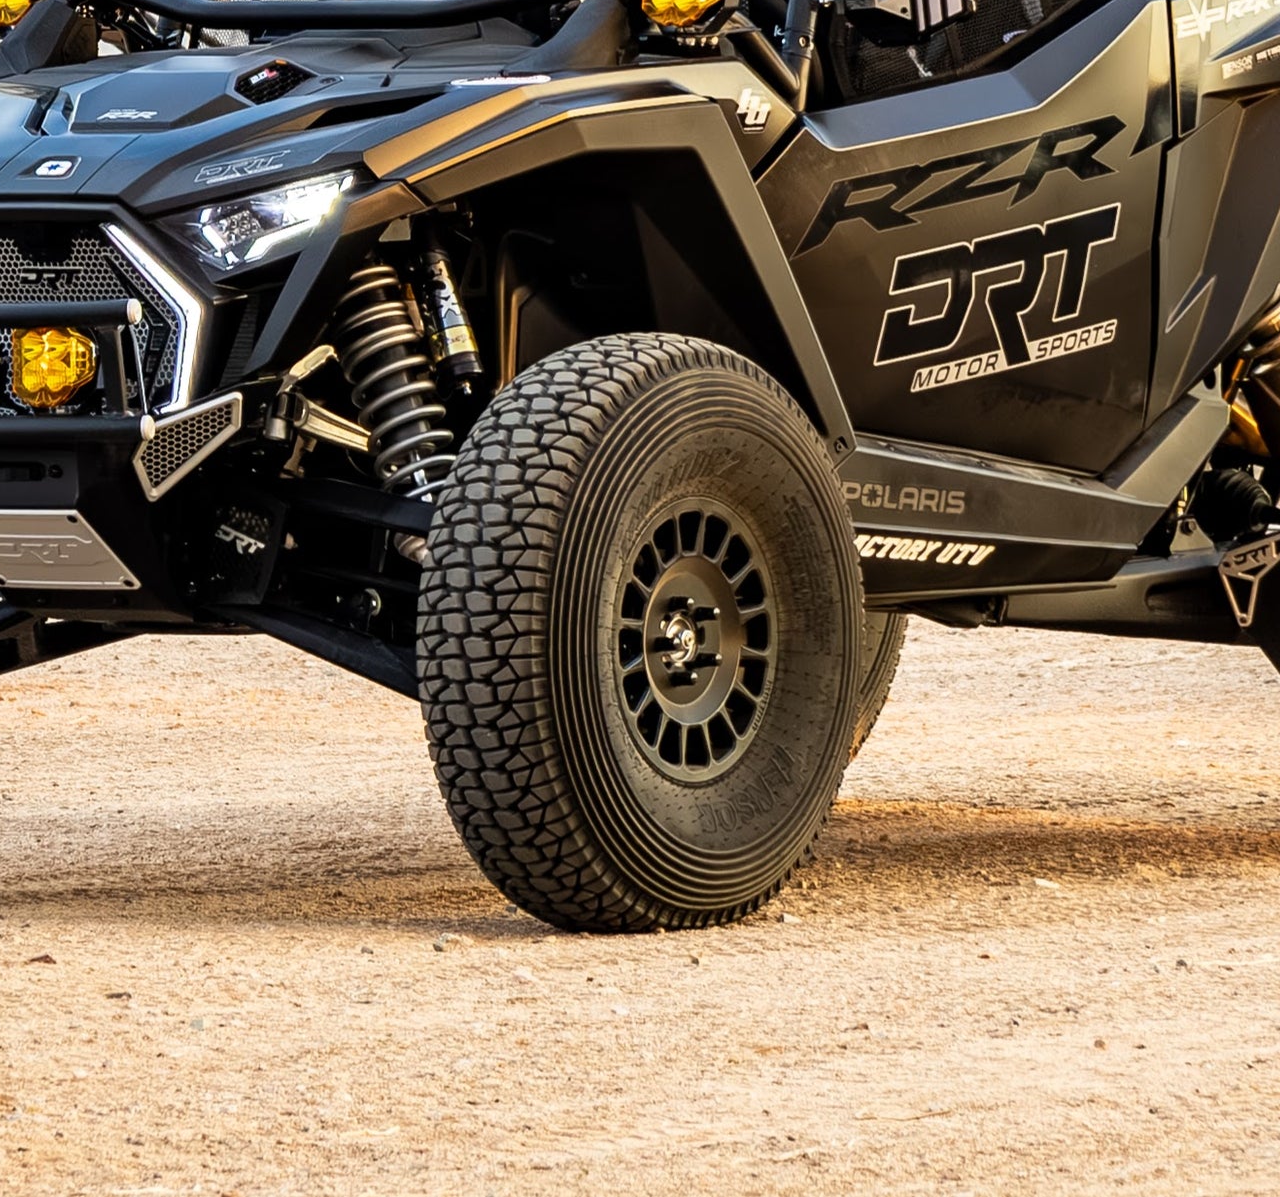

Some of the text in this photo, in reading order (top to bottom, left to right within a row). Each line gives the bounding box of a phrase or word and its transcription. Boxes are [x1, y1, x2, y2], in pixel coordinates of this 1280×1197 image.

[790, 115, 1127, 260] RZR
[873, 202, 1122, 368] DRT
[1035, 321, 1116, 360] SPORTS
[912, 353, 999, 391] MOTOR
[841, 481, 966, 515] POLARIS
[853, 534, 995, 566] ACTORY UTV
